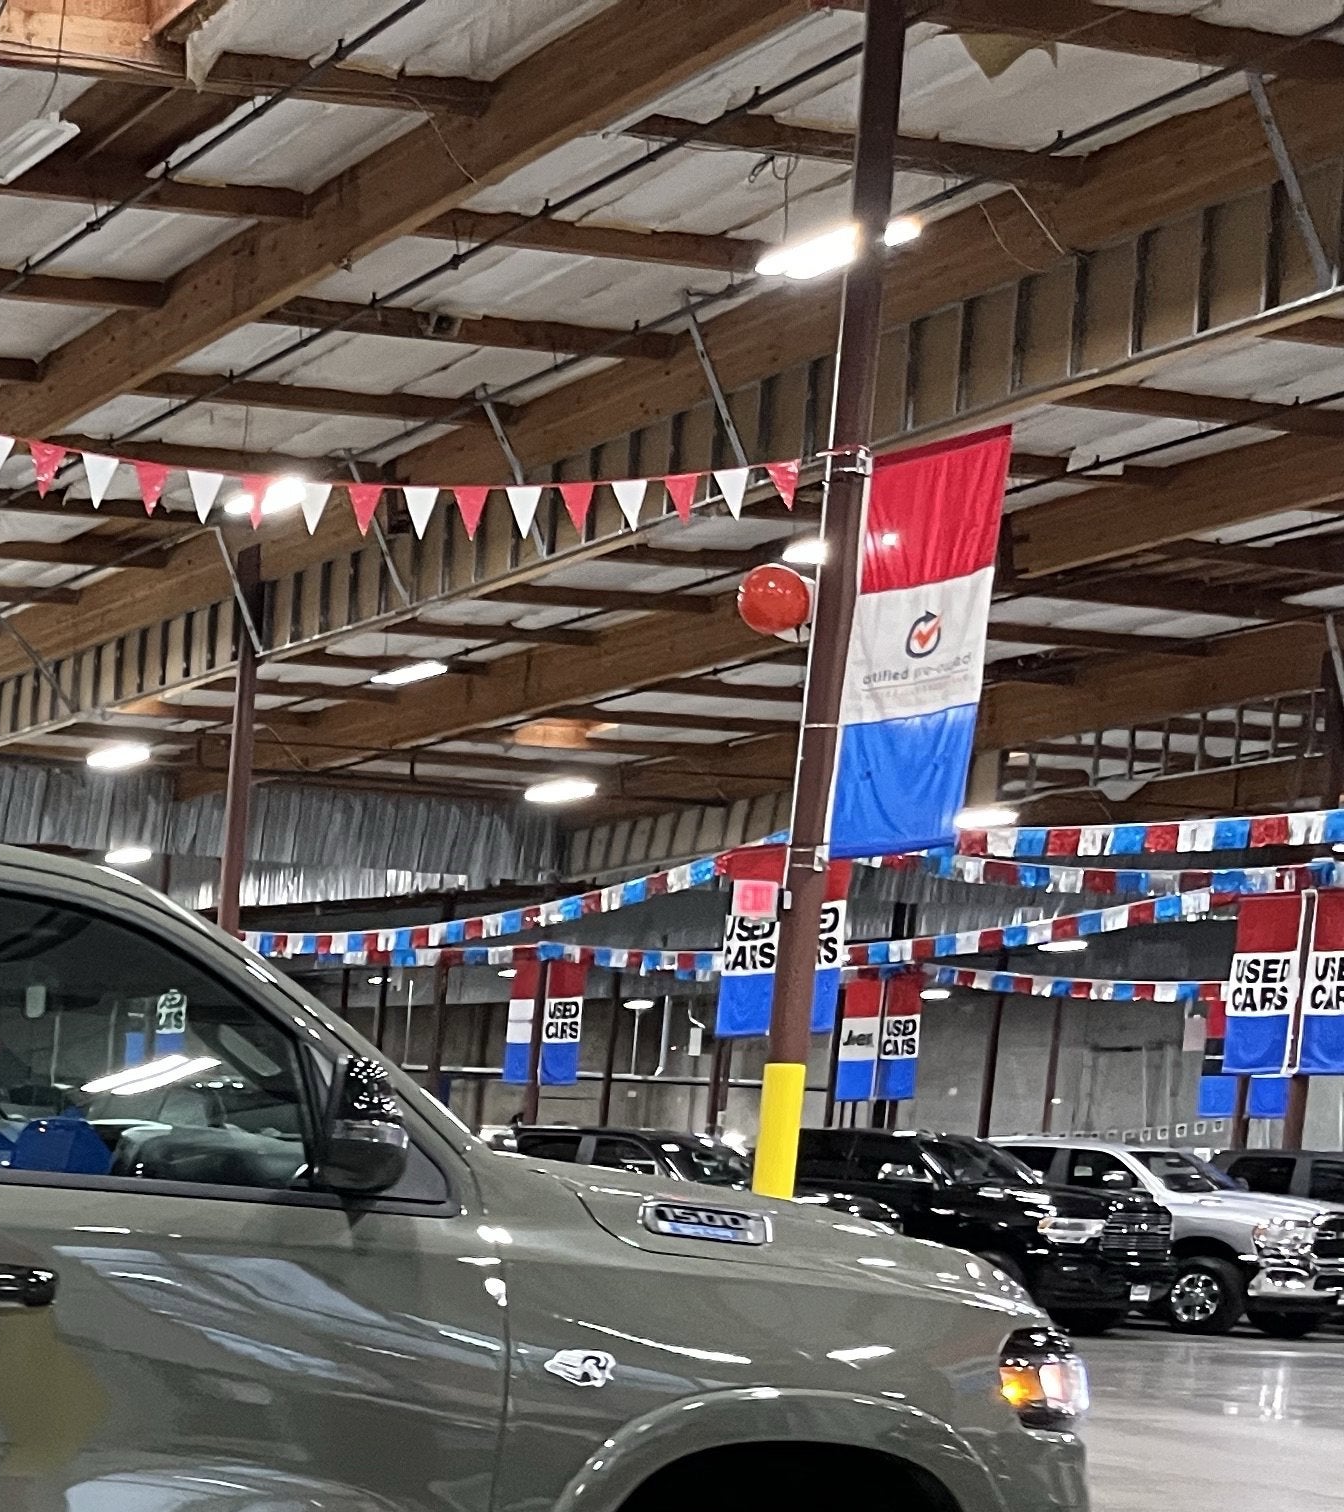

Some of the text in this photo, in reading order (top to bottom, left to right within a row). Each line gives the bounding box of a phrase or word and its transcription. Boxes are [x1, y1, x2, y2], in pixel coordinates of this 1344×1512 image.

[1236, 958, 1291, 983] USED
[548, 1001, 580, 1019] USED
[1232, 985, 1288, 1011] CARS
[658, 1205, 748, 1230] 1500
